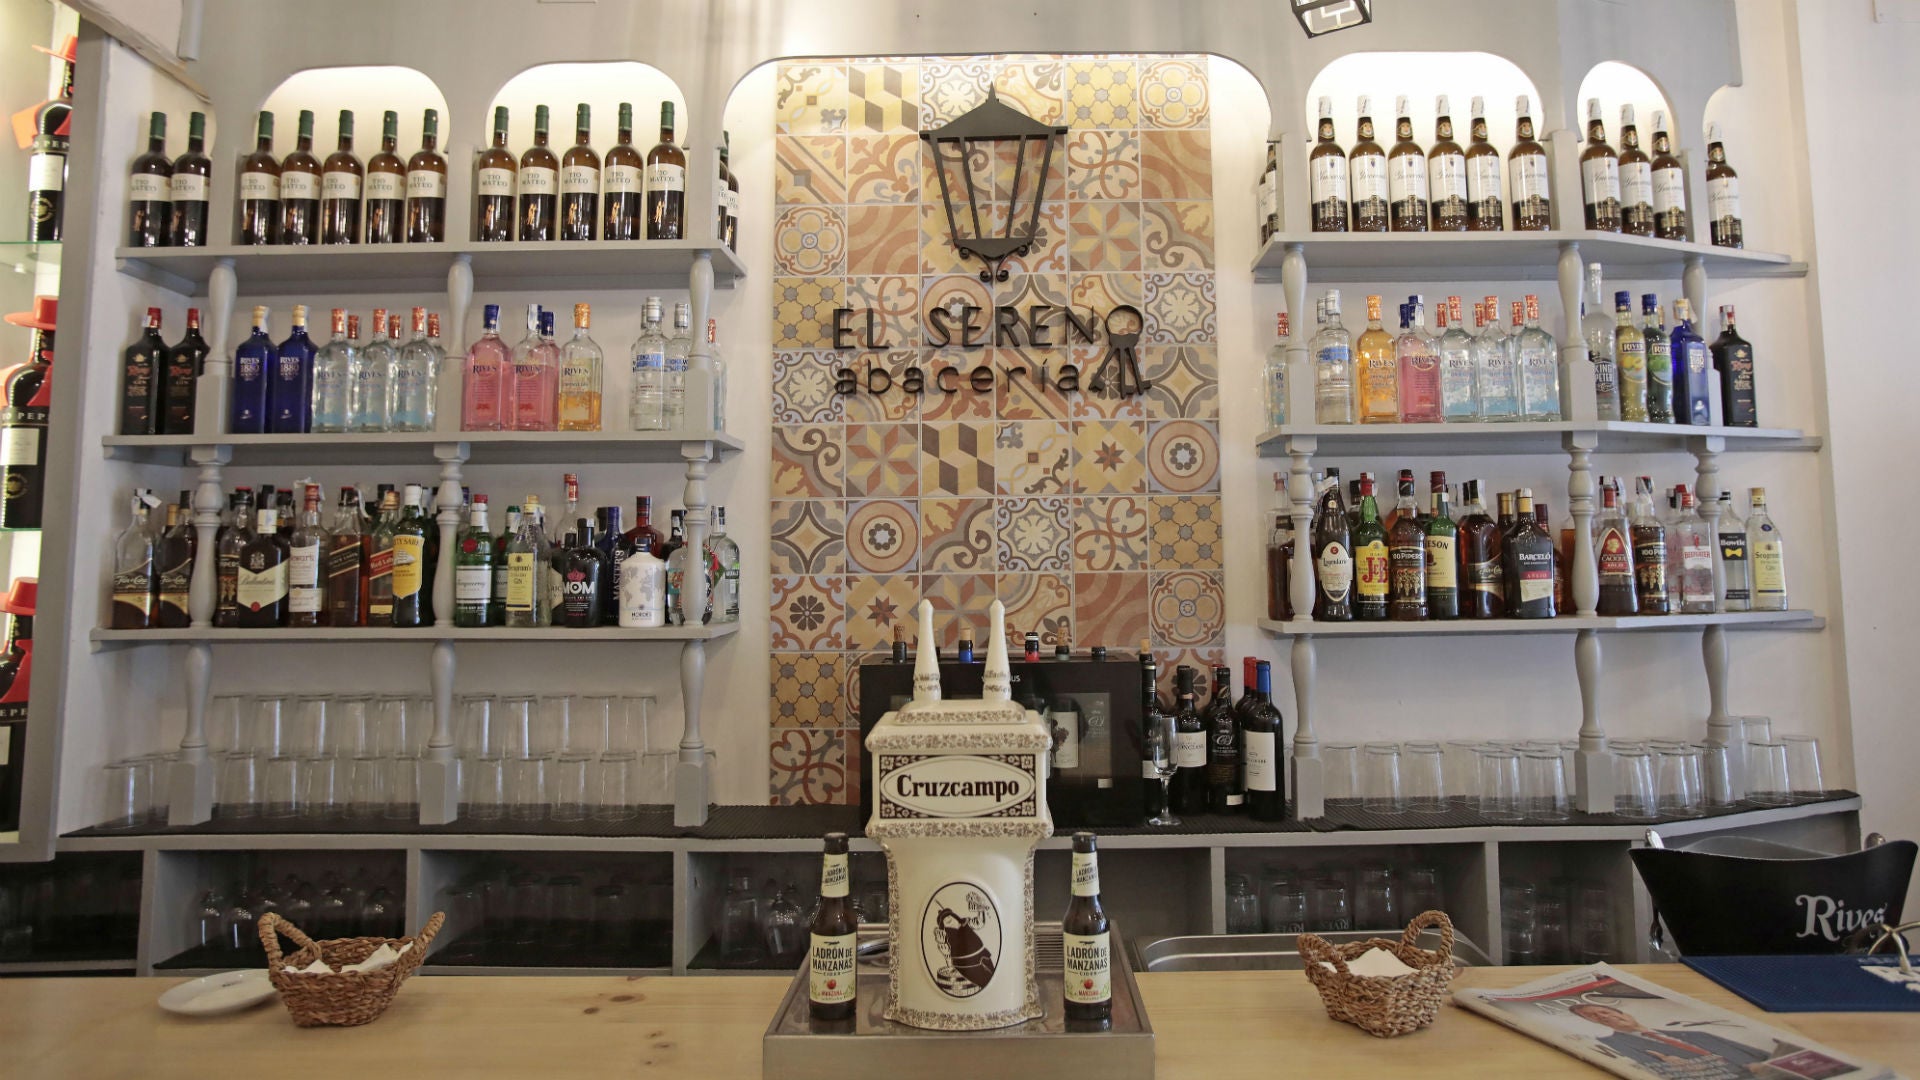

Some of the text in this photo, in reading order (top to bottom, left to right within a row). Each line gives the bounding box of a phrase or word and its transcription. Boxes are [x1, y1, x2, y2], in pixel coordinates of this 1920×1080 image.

[832, 307, 890, 350] EL
[473, 365, 497, 374] RIVES
[564, 367, 589, 376] RIVES
[833, 358, 1080, 396] abacería
[18, 412, 46, 420] PEP
[1428, 540, 1449, 550] ESON
[1401, 552, 1423, 560] PIPERS
[1519, 551, 1551, 561] BARCELÓ
[562, 581, 596, 594] MOM
[896, 774, 1020, 803] Cruzcampo
[1795, 894, 1888, 941] Rives
[812, 946, 853, 959] LADRÓN DE
[1066, 945, 1107, 959] LADRÓN DE
[812, 958, 853, 971] MANZANAS
[1066, 957, 1108, 971] MANZANAS
